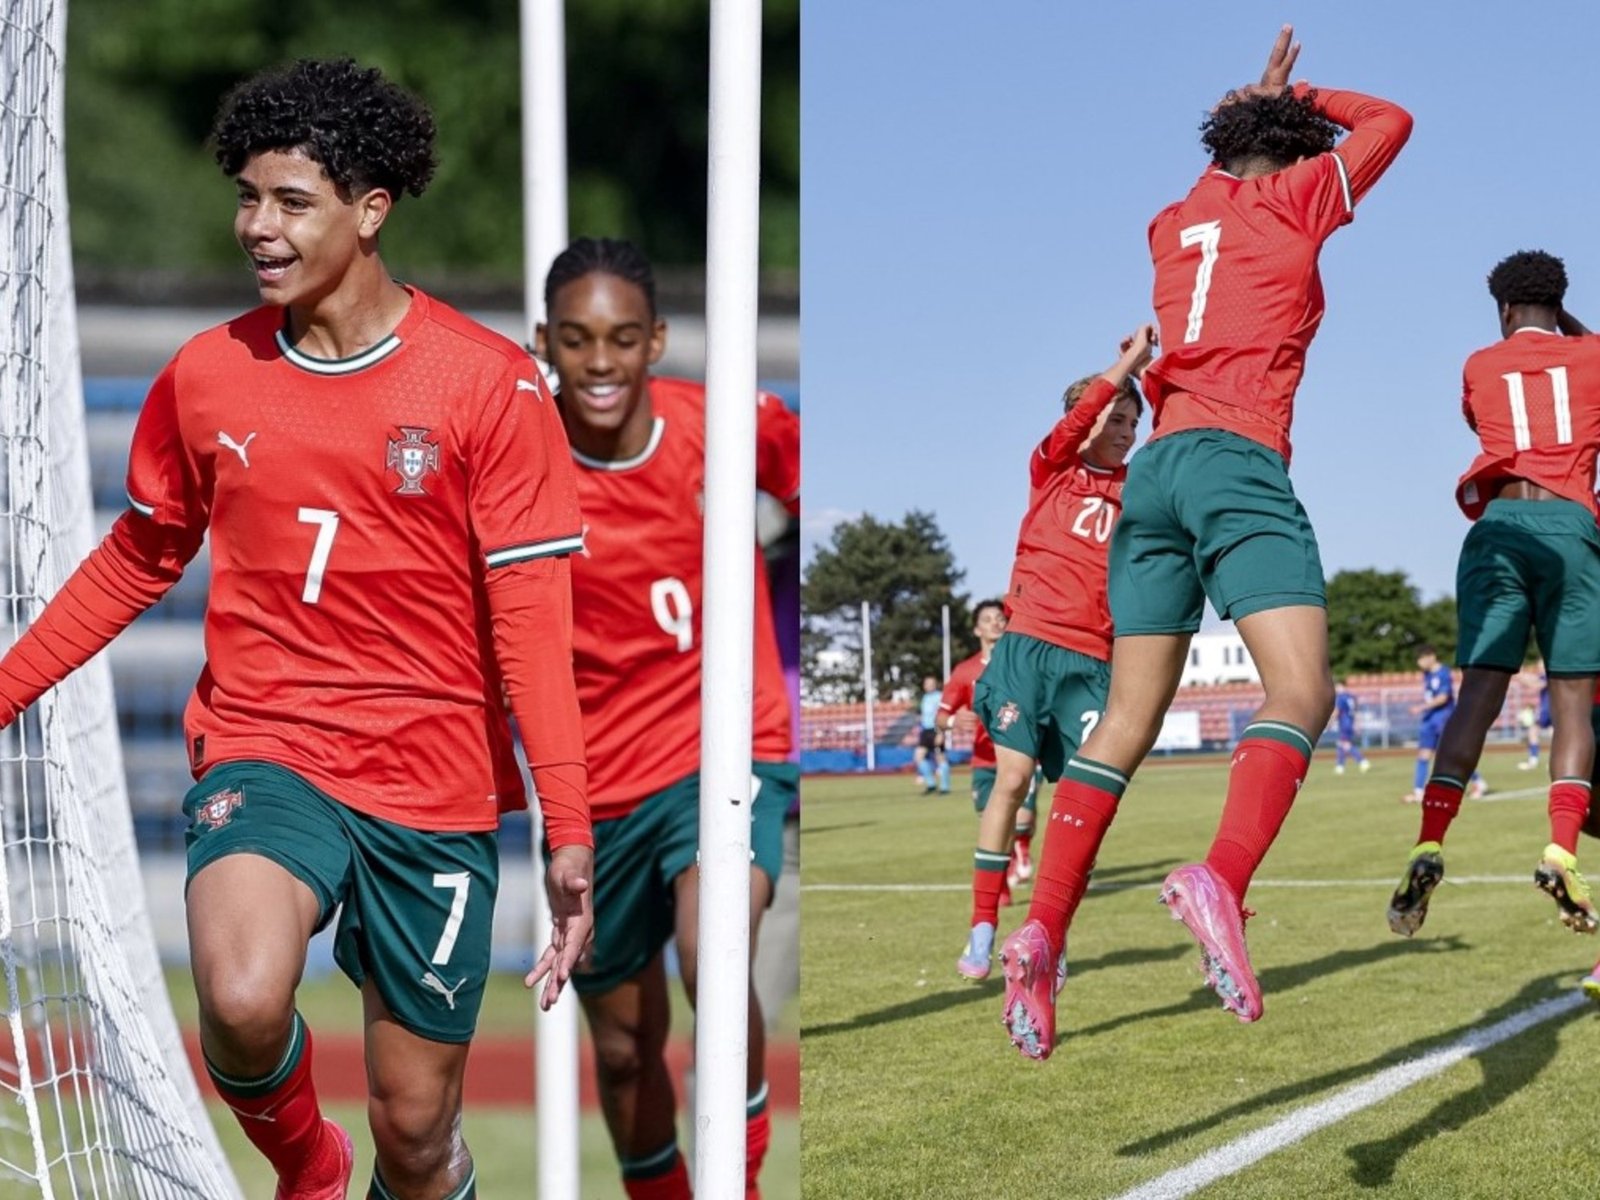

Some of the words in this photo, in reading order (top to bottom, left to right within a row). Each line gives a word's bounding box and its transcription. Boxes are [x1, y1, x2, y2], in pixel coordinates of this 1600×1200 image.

[1180, 219, 1222, 344] 7
[1501, 366, 1572, 452] 11
[297, 507, 339, 604] 7
[1072, 496, 1114, 543] 20
[650, 576, 693, 653] 9
[432, 871, 470, 965] 7
